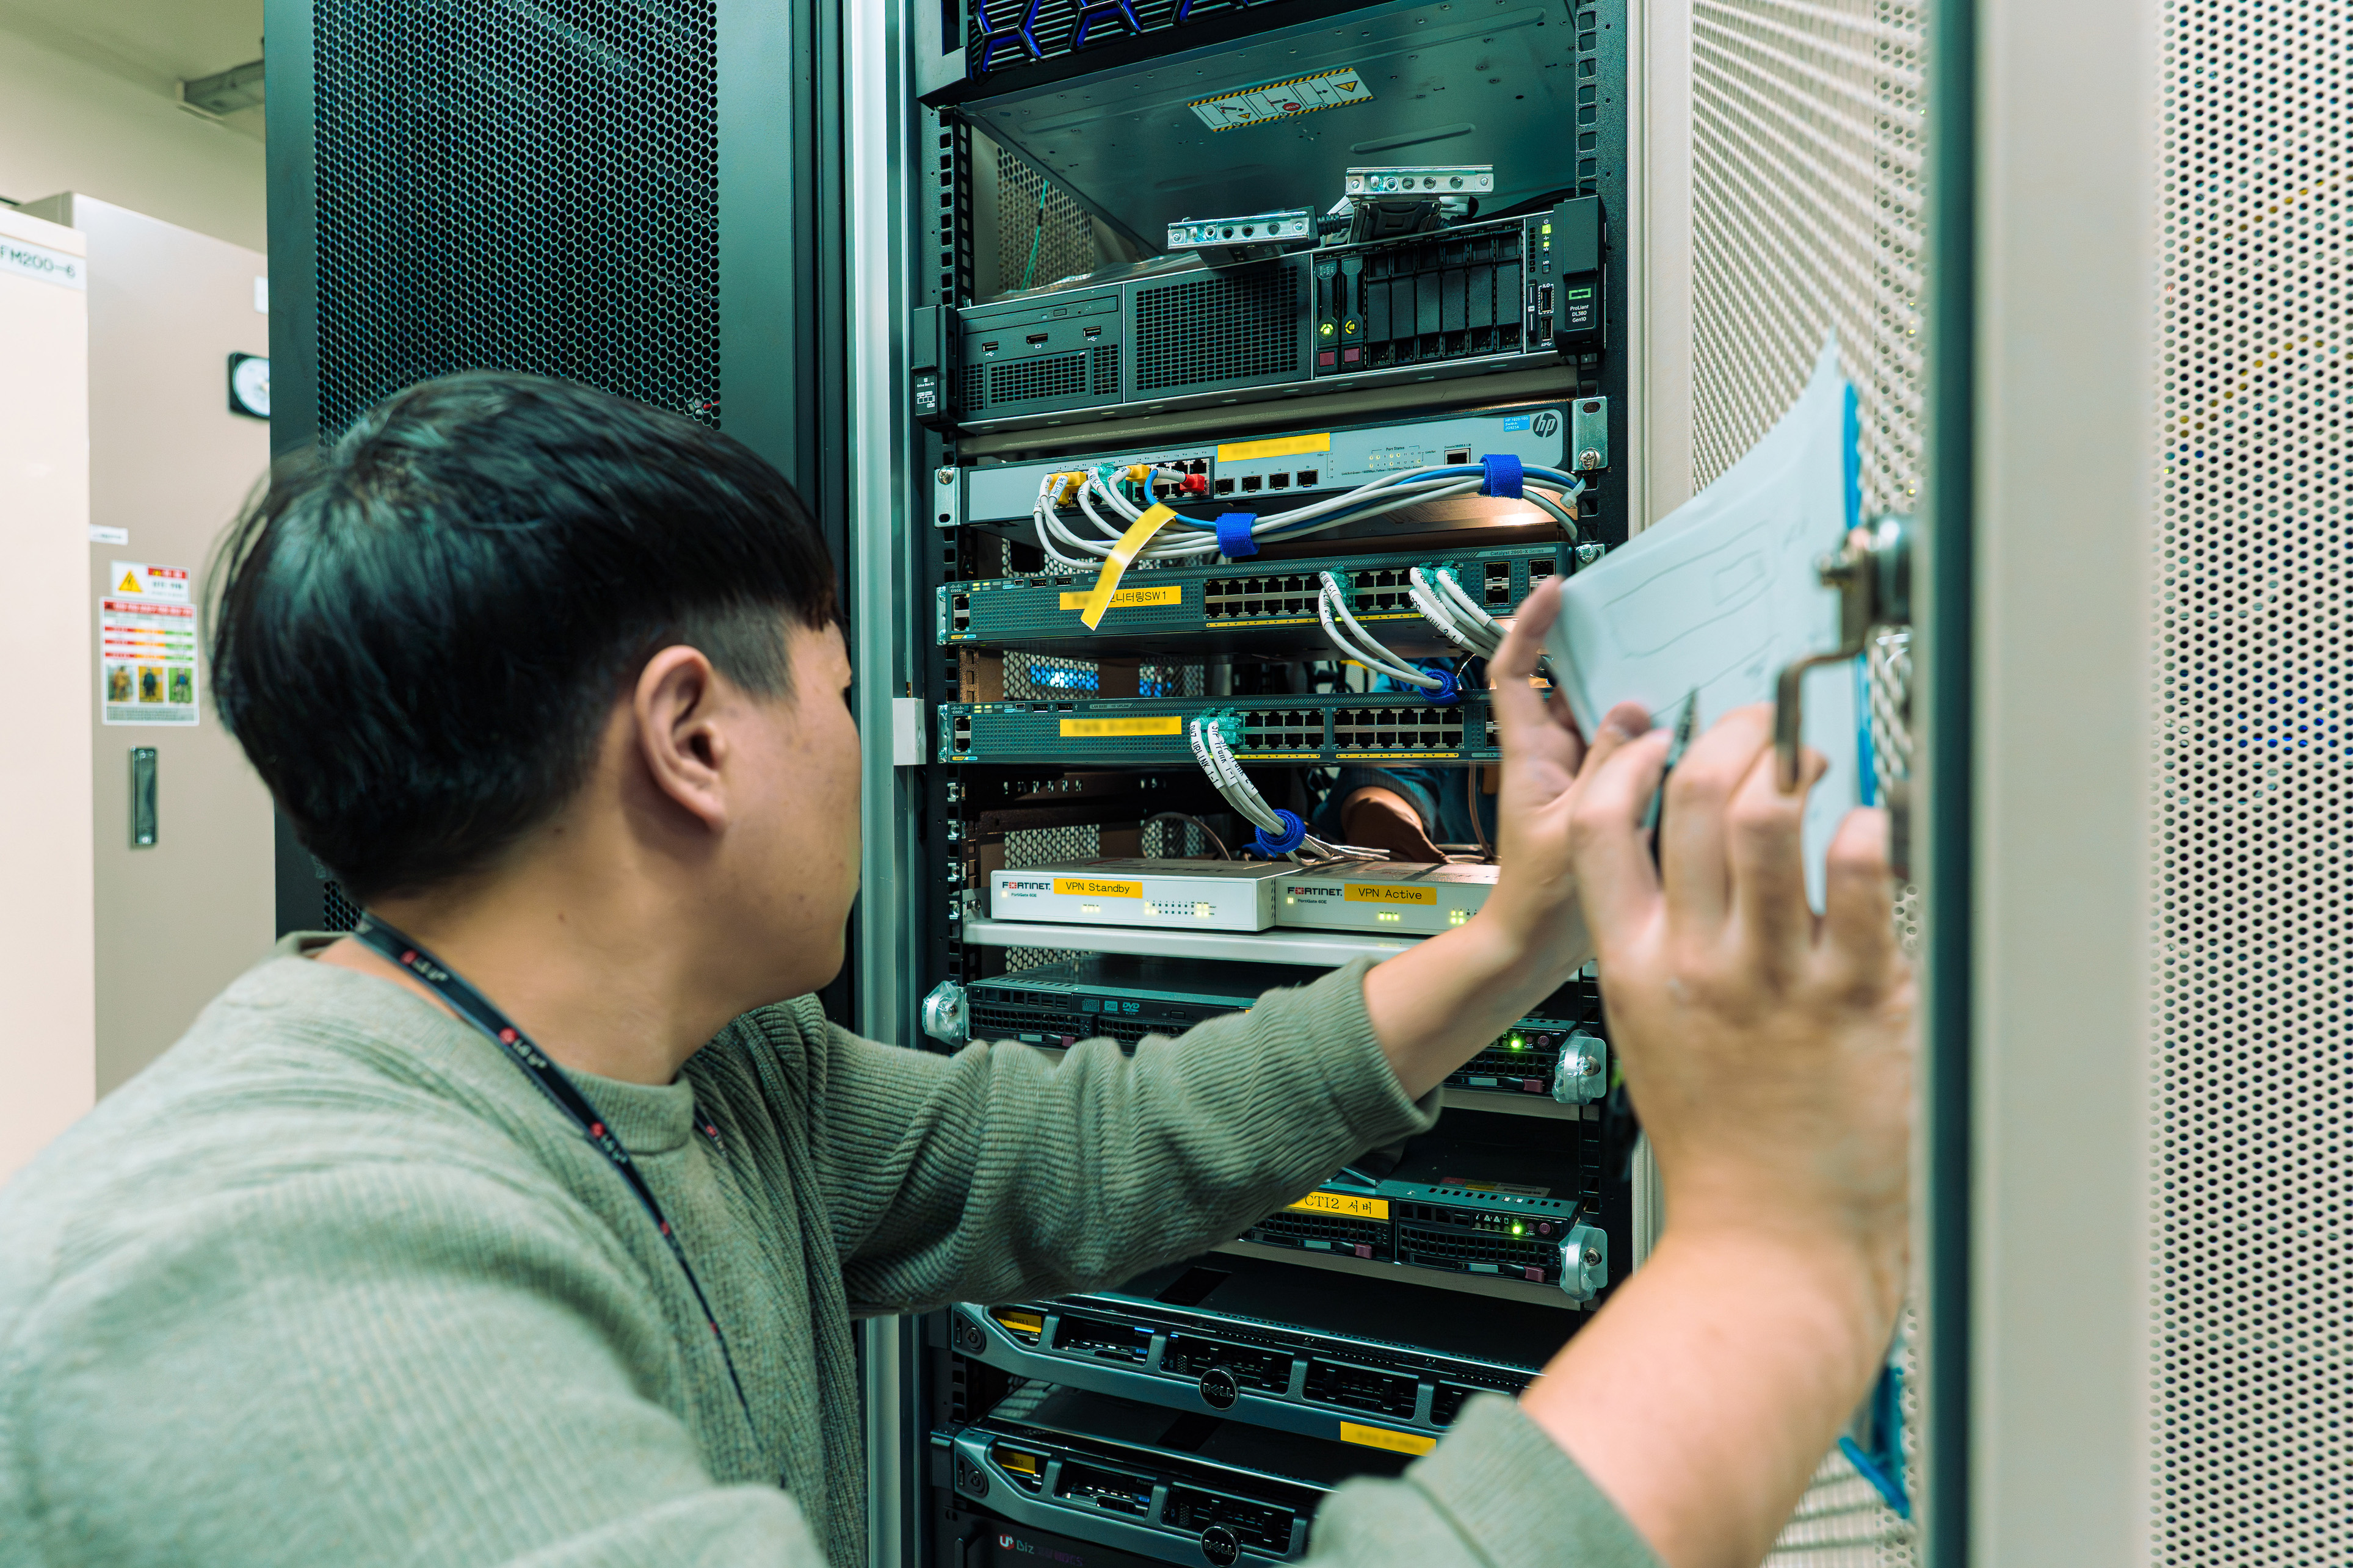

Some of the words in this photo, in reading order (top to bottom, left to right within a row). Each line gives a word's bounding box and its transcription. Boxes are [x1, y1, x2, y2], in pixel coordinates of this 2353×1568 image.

[1535, 413, 1556, 438] hp
[1192, 741, 1210, 770] UPLINK
[1208, 771, 1219, 784] 1-1
[1065, 881, 1084, 891] VPN
[1089, 883, 1129, 894] Standby
[1358, 887, 1379, 898] VPN
[1385, 889, 1422, 900] Active
[1305, 1194, 1340, 1209] CTI2
[1347, 1199, 1372, 1215] 서버
[1203, 1382, 1233, 1398] DELL
[1017, 1539, 1035, 1555] Biz
[1205, 1539, 1235, 1556] DELL
